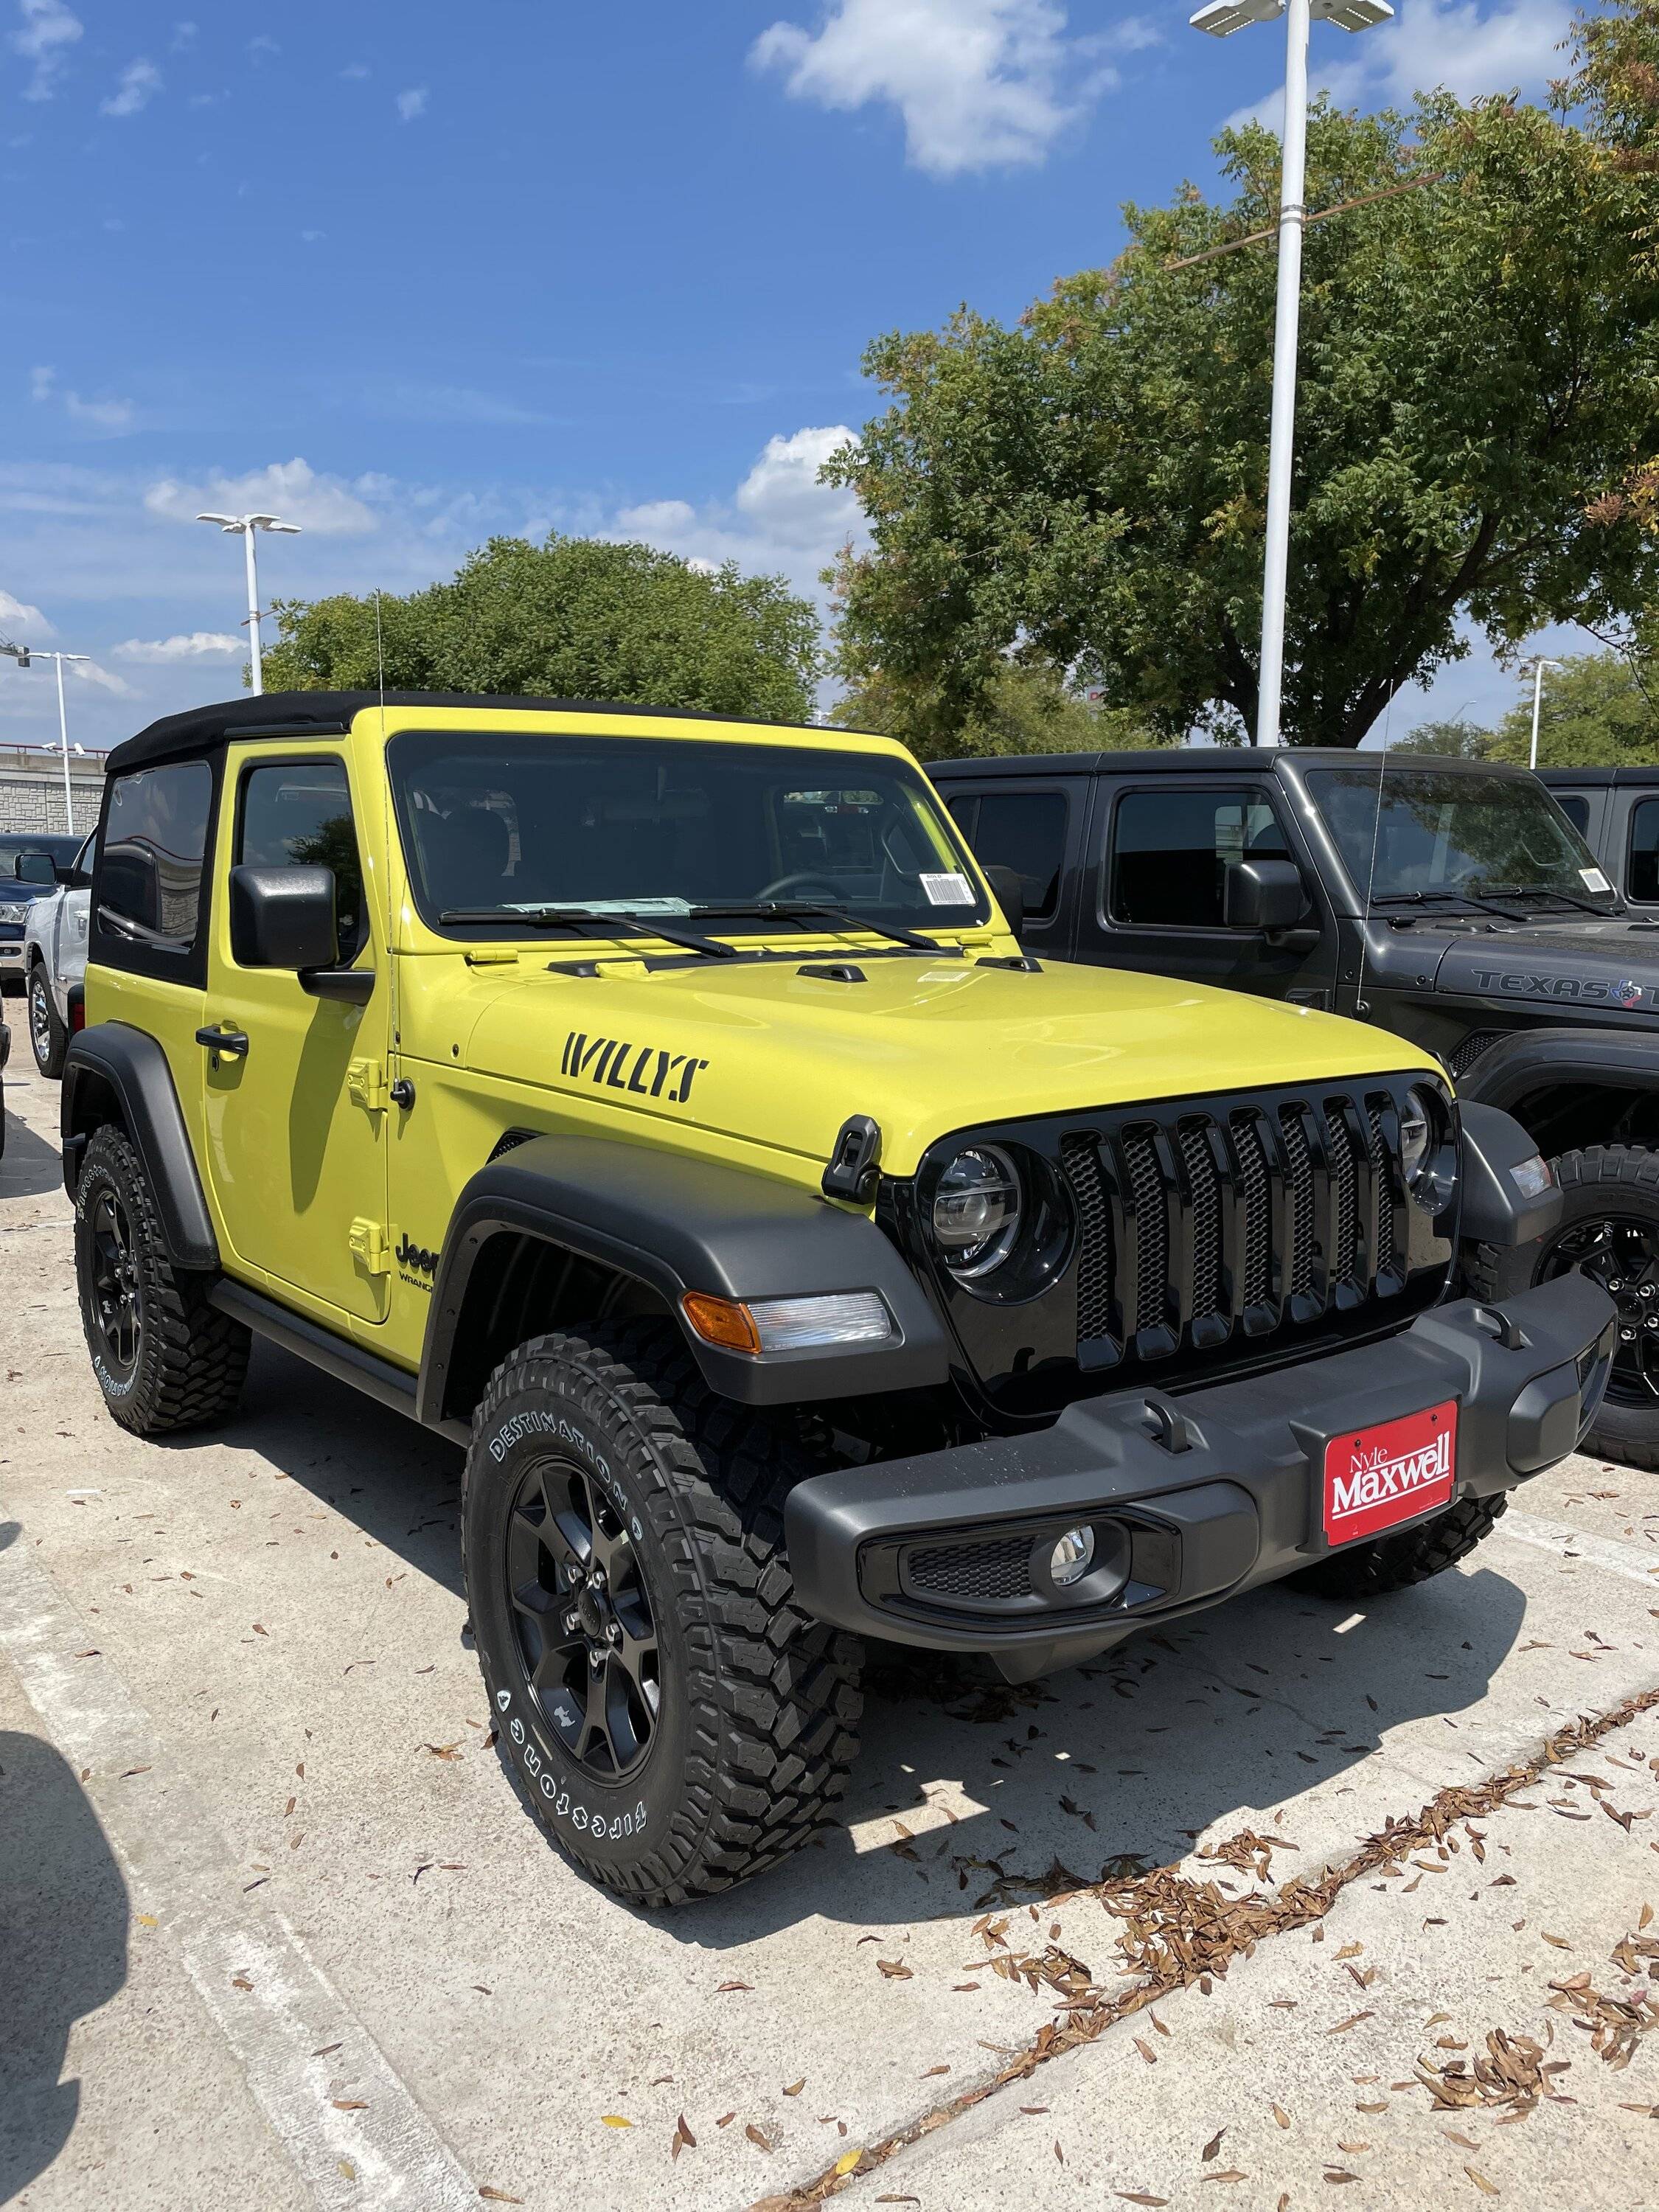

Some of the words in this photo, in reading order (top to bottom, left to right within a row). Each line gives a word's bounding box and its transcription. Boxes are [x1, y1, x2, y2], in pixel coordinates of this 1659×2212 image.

[1471, 968, 1610, 1001] TEXAS
[561, 1032, 710, 1103] WILLYS
[395, 1232, 440, 1281] Jeep
[399, 1270, 434, 1293] WRANG
[489, 1410, 628, 1511] DESTINATION
[1332, 1430, 1450, 1514] Maxwell
[1349, 1446, 1388, 1473] Nyle
[510, 1718, 647, 1840] Firestone
